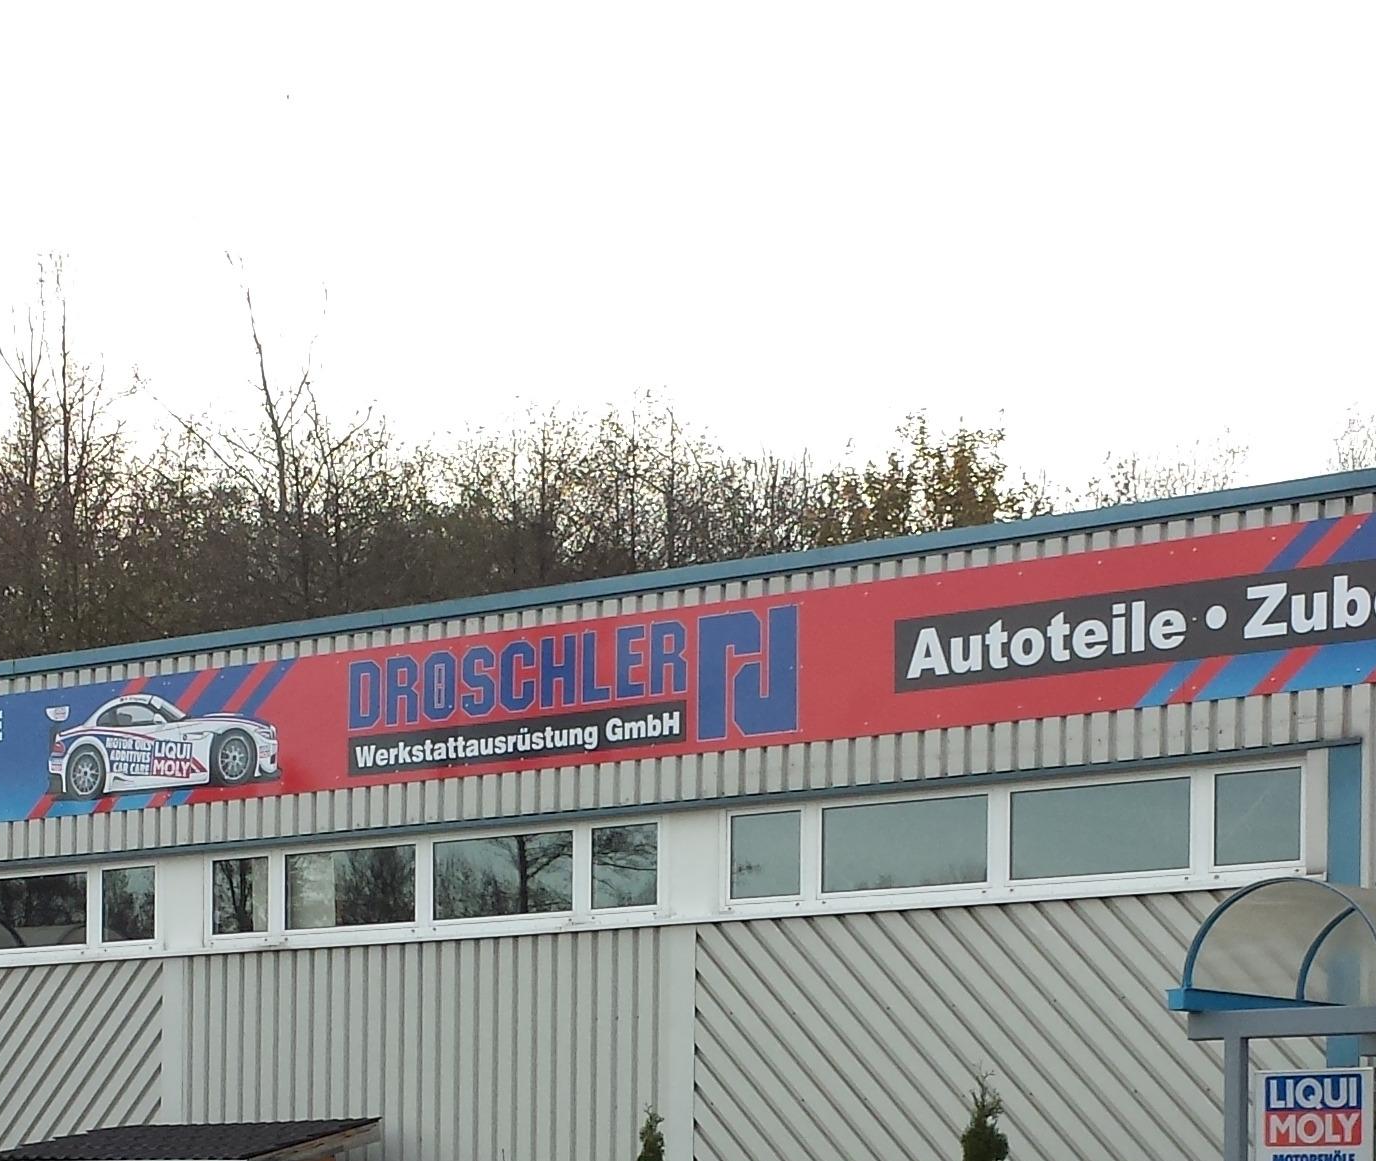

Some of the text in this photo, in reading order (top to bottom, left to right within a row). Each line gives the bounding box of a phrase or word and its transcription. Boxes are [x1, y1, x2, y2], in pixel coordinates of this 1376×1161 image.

[905, 600, 1187, 680] Autoteile
[105, 736, 152, 751] MOTOR OILS
[355, 711, 681, 769] Werkstattausrüstung GmbH
[110, 749, 151, 763] ADDITIVES
[154, 741, 191, 759] LIQUI
[113, 761, 150, 775] CAR CARE
[153, 758, 191, 777] MOLY
[1270, 1077, 1357, 1109] LIQUI
[1270, 1113, 1360, 1143] MOLY
